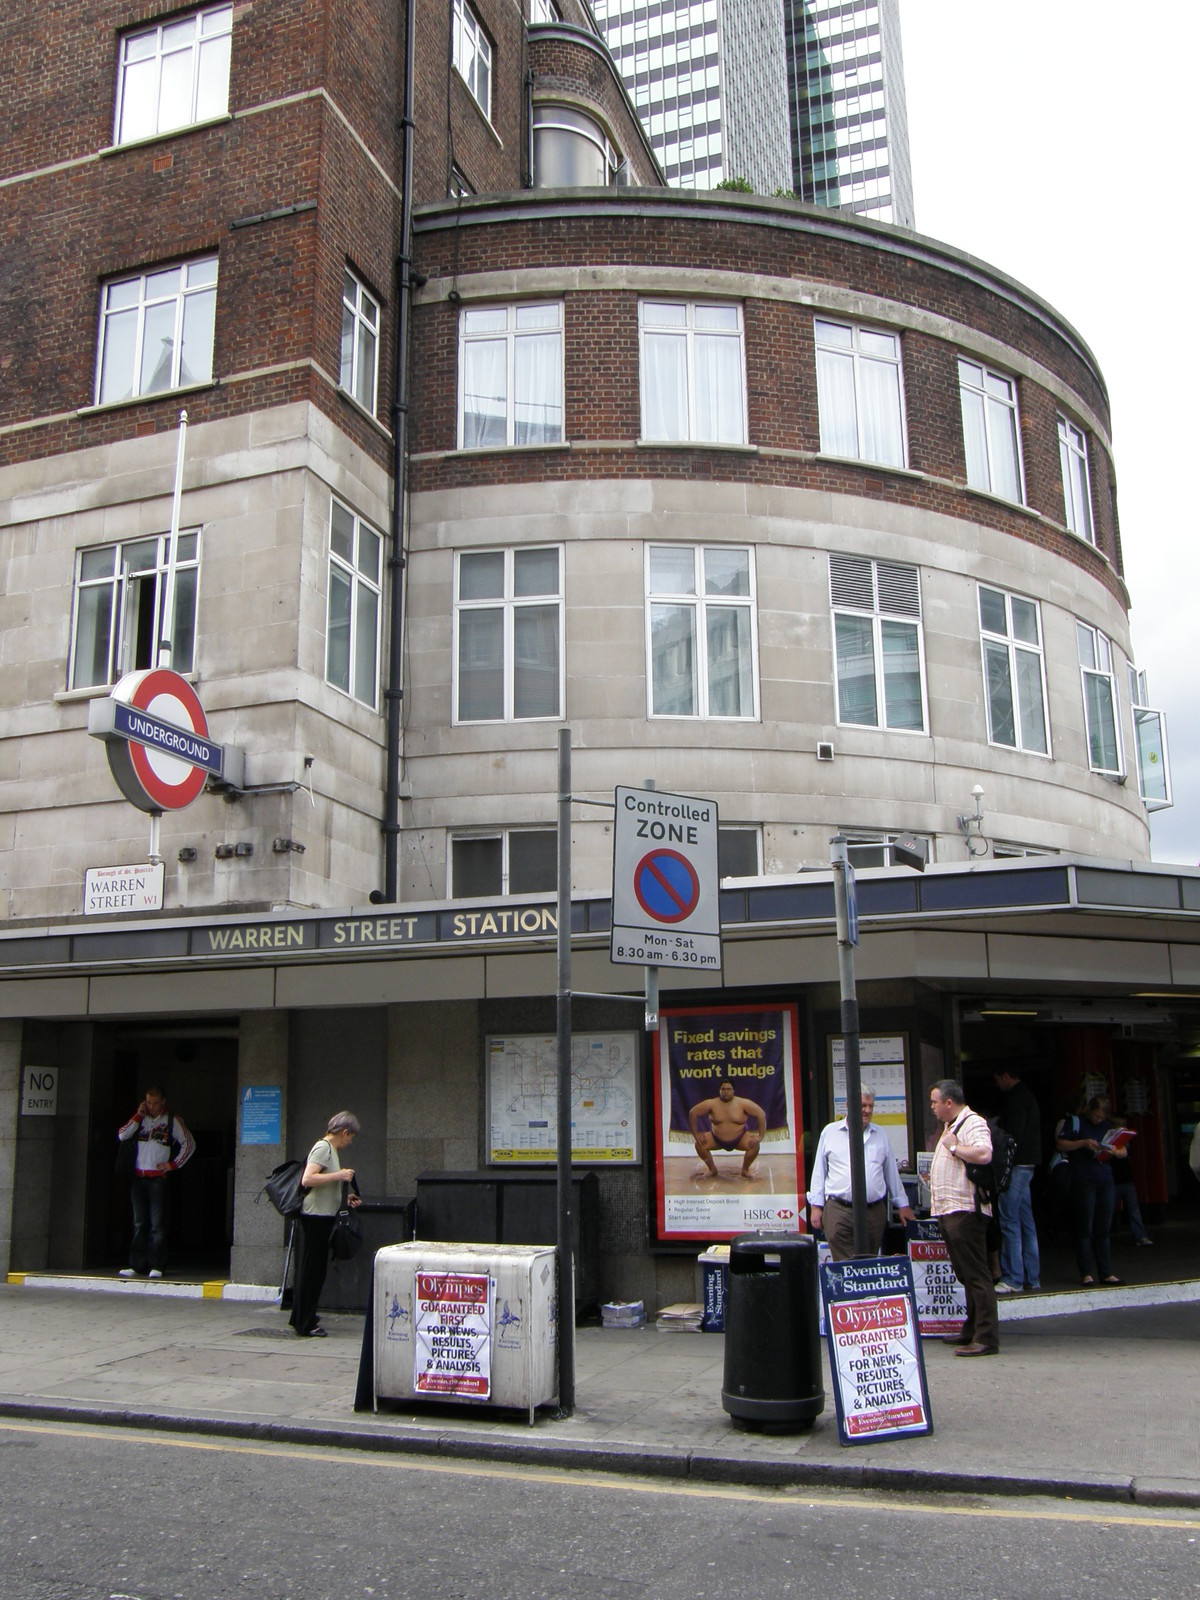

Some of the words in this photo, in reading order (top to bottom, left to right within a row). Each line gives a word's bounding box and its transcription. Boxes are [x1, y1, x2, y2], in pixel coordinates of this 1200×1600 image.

[128, 715, 209, 761] UNDERGROUND
[624, 795, 710, 823] Controlled
[636, 818, 698, 845] ZONE
[134, 867, 154, 875] Pancras
[91, 878, 145, 893] WARREN
[90, 893, 136, 909] STREET
[143, 895, 157, 905] W1
[208, 925, 304, 950] WARREN
[334, 917, 418, 943] STREET
[453, 907, 558, 936] STATION
[644, 934, 667, 946] Mon
[675, 937, 695, 949] Sat
[617, 946, 645, 959] 8.30
[646, 951, 663, 960] am
[671, 950, 698, 962] 6.30
[700, 954, 717, 965] pm
[674, 1029, 714, 1043] Fixed
[718, 1028, 776, 1044] savings
[687, 1048, 725, 1060] rates
[730, 1046, 763, 1060] that
[680, 1065, 722, 1078] won't
[727, 1063, 775, 1079] budge
[30, 1072, 54, 1091] NO
[28, 1099, 54, 1109] ENTRY
[744, 1209, 775, 1220] HSBC
[842, 1263, 901, 1278] Evening
[422, 1277, 483, 1299] Olympics
[843, 1276, 909, 1293] Standard
[925, 1275, 957, 1286] GOLD
[706, 1273, 715, 1313] Evening
[714, 1269, 722, 1315] Standard
[927, 1285, 957, 1295] HAUL
[932, 1294, 953, 1304] FOR
[420, 1302, 485, 1315] GUARANTEED
[836, 1302, 903, 1329] Olympics
[440, 1315, 465, 1326] FIRST
[427, 1326, 446, 1336] FOR
[450, 1327, 479, 1339] NEWS,
[838, 1328, 907, 1347] GUARANTEED
[432, 1337, 474, 1349] RESULTS,
[861, 1343, 888, 1356] FIRST
[431, 1349, 476, 1360] PICTURES
[426, 1359, 433, 1369] &
[436, 1360, 481, 1372] ANALYSIS
[849, 1358, 870, 1371] FOR
[872, 1354, 905, 1369] NEWS,
[856, 1368, 902, 1383] RESULTS,
[856, 1379, 905, 1396] PICTURES
[854, 1399, 862, 1409] &
[865, 1390, 912, 1407] ANALYSIS
